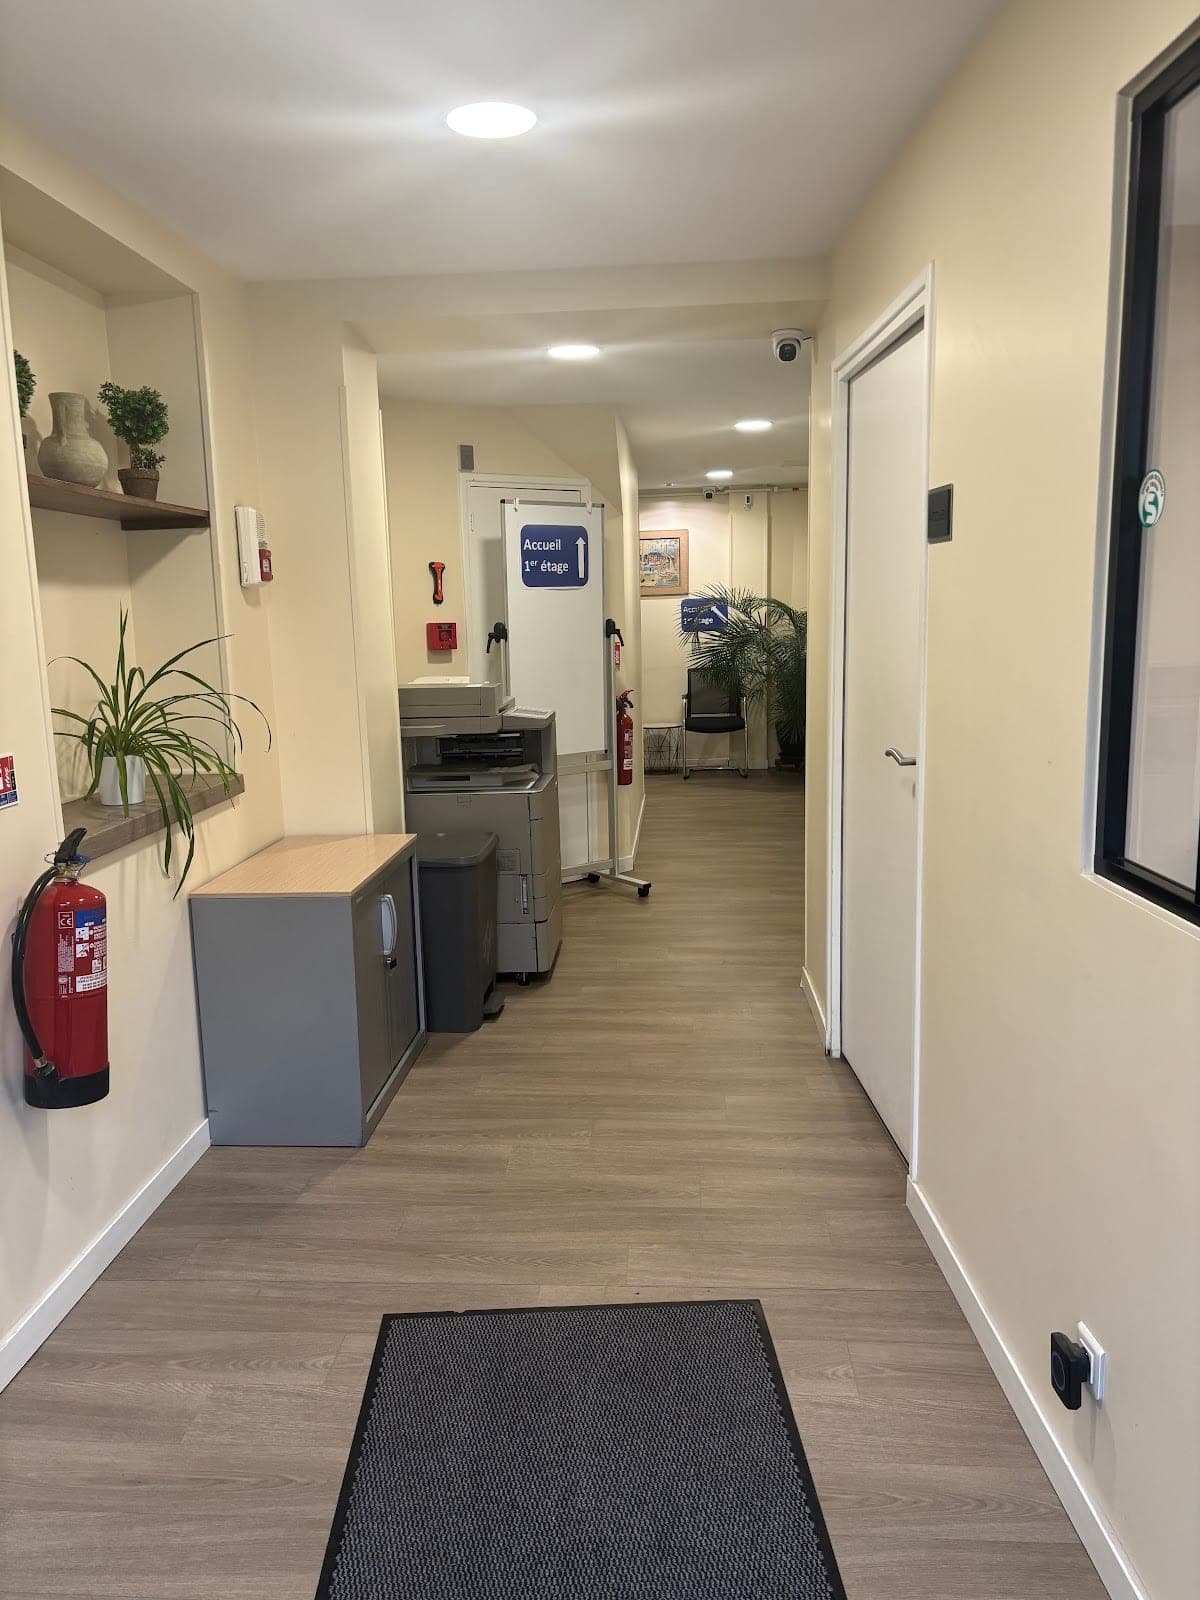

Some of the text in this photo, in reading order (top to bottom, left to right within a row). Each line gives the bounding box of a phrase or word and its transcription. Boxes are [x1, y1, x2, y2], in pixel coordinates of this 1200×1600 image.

[523, 539, 561, 551] Accueil
[524, 560, 569, 574] 1er étage
